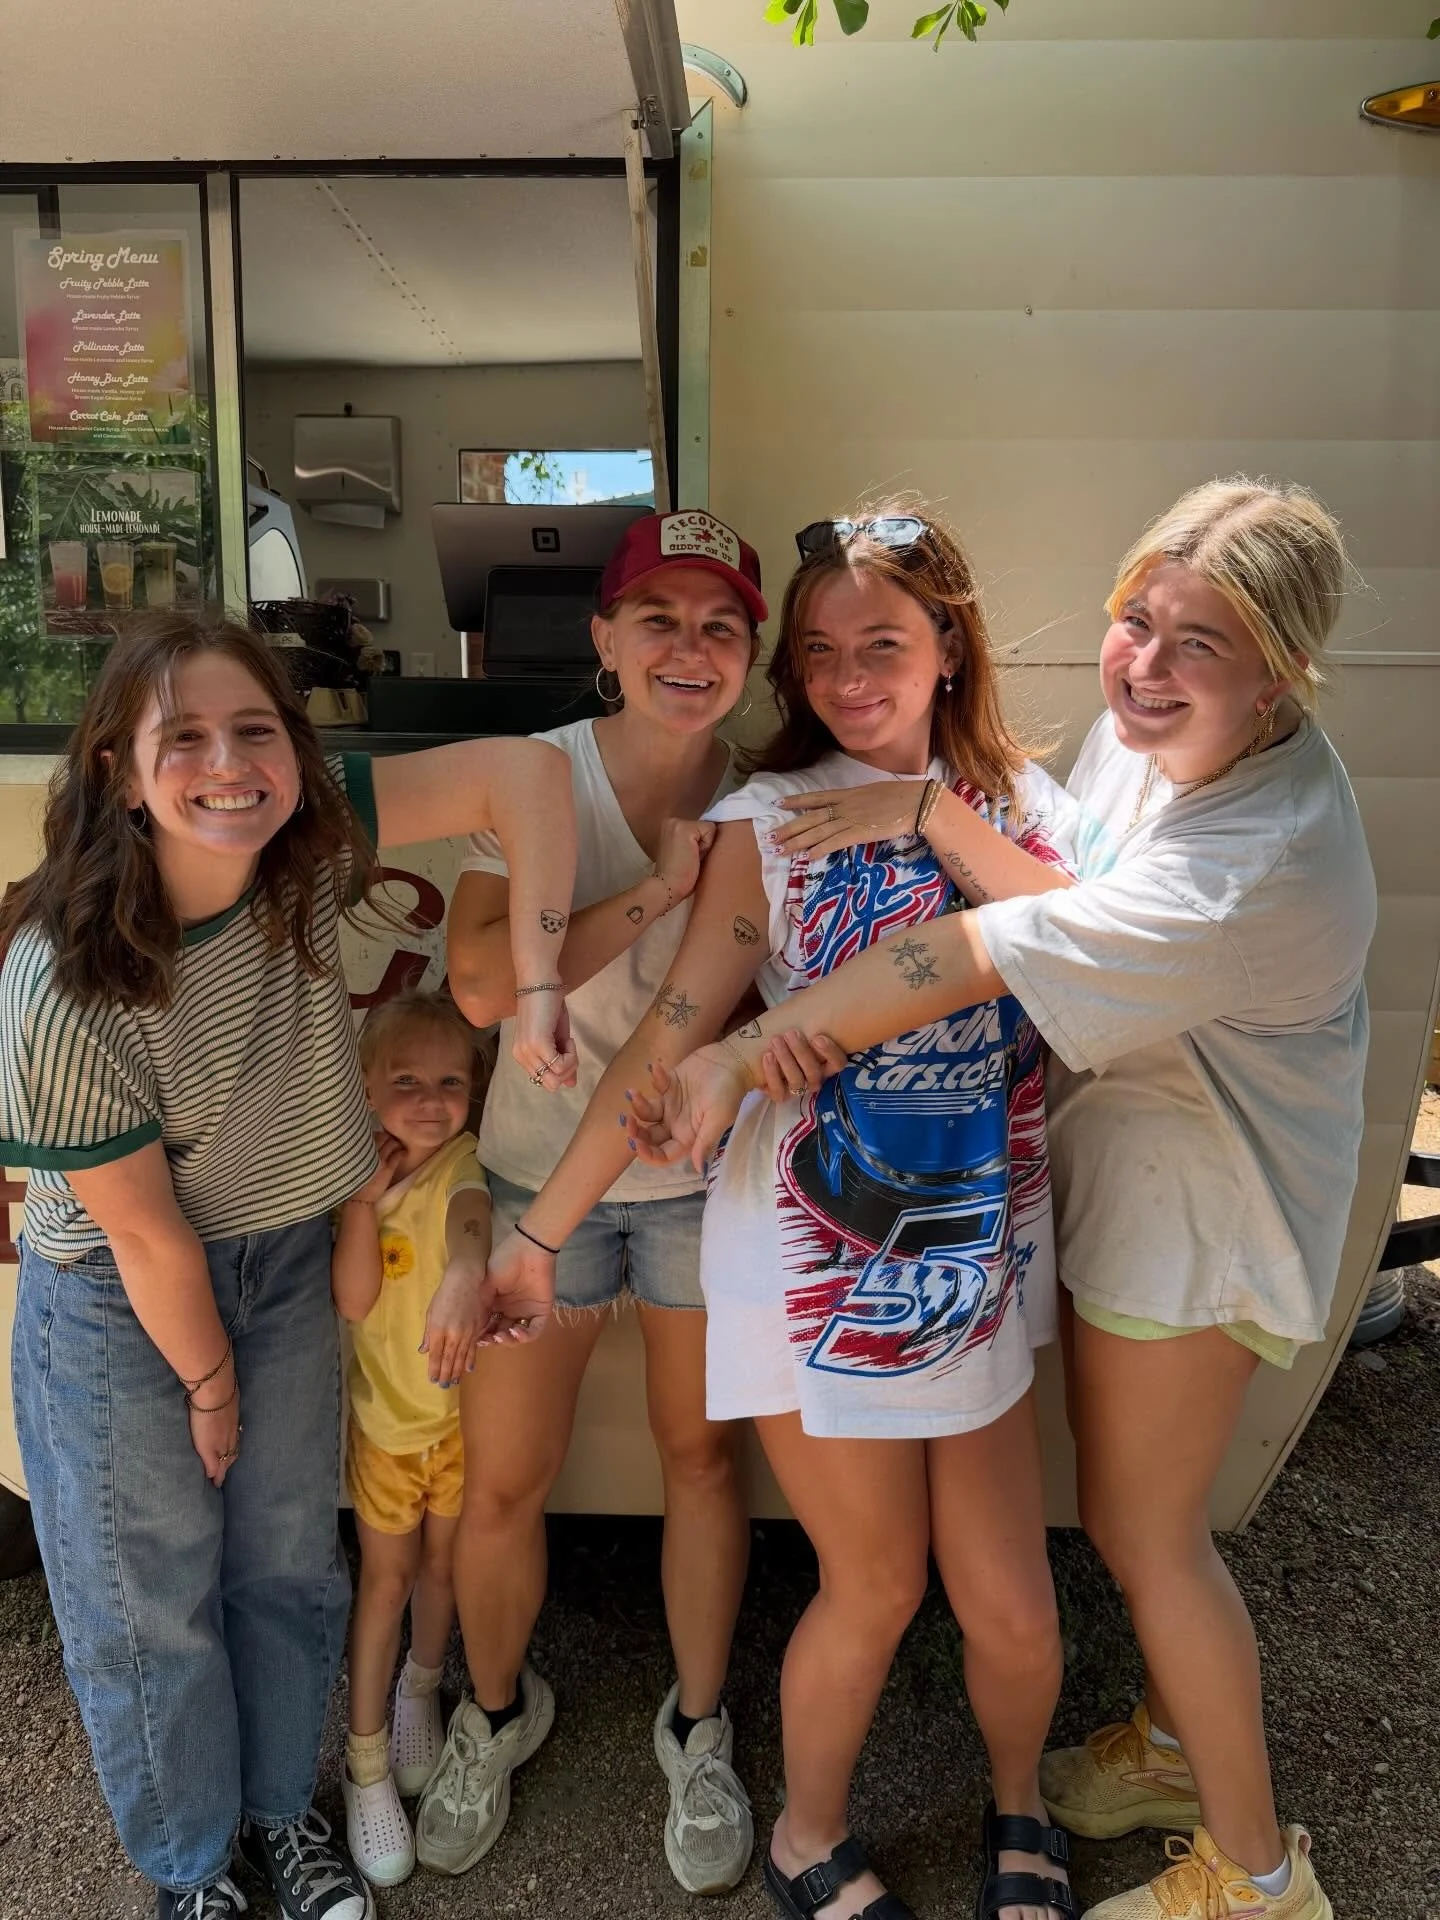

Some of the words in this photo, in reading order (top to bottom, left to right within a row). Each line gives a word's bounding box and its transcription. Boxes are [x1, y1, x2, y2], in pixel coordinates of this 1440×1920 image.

[47, 246, 104, 271] Spring
[106, 246, 159, 269] Menu
[59, 277, 92, 291] Fruity
[93, 277, 124, 290] Pebble
[123, 277, 150, 292] Latte
[72, 309, 115, 323] Lavender
[115, 309, 141, 324] Latte
[72, 340, 119, 353] Pollinator
[119, 341, 144, 356] Latte
[67, 371, 100, 386] Honey
[99, 373, 123, 387] Bun
[122, 373, 149, 387] Latte
[69, 409, 99, 421] Carrot
[99, 410, 122, 422] Cake
[122, 410, 149, 425] Latte
[125, 522, 160, 534] LEMONADE
[668, 515, 734, 545] TECOVAS
[669, 543, 701, 551] GIDDY
[704, 546, 718, 555] ON
[721, 552, 733, 562] UP
[805, 1193, 1007, 1378] 5
